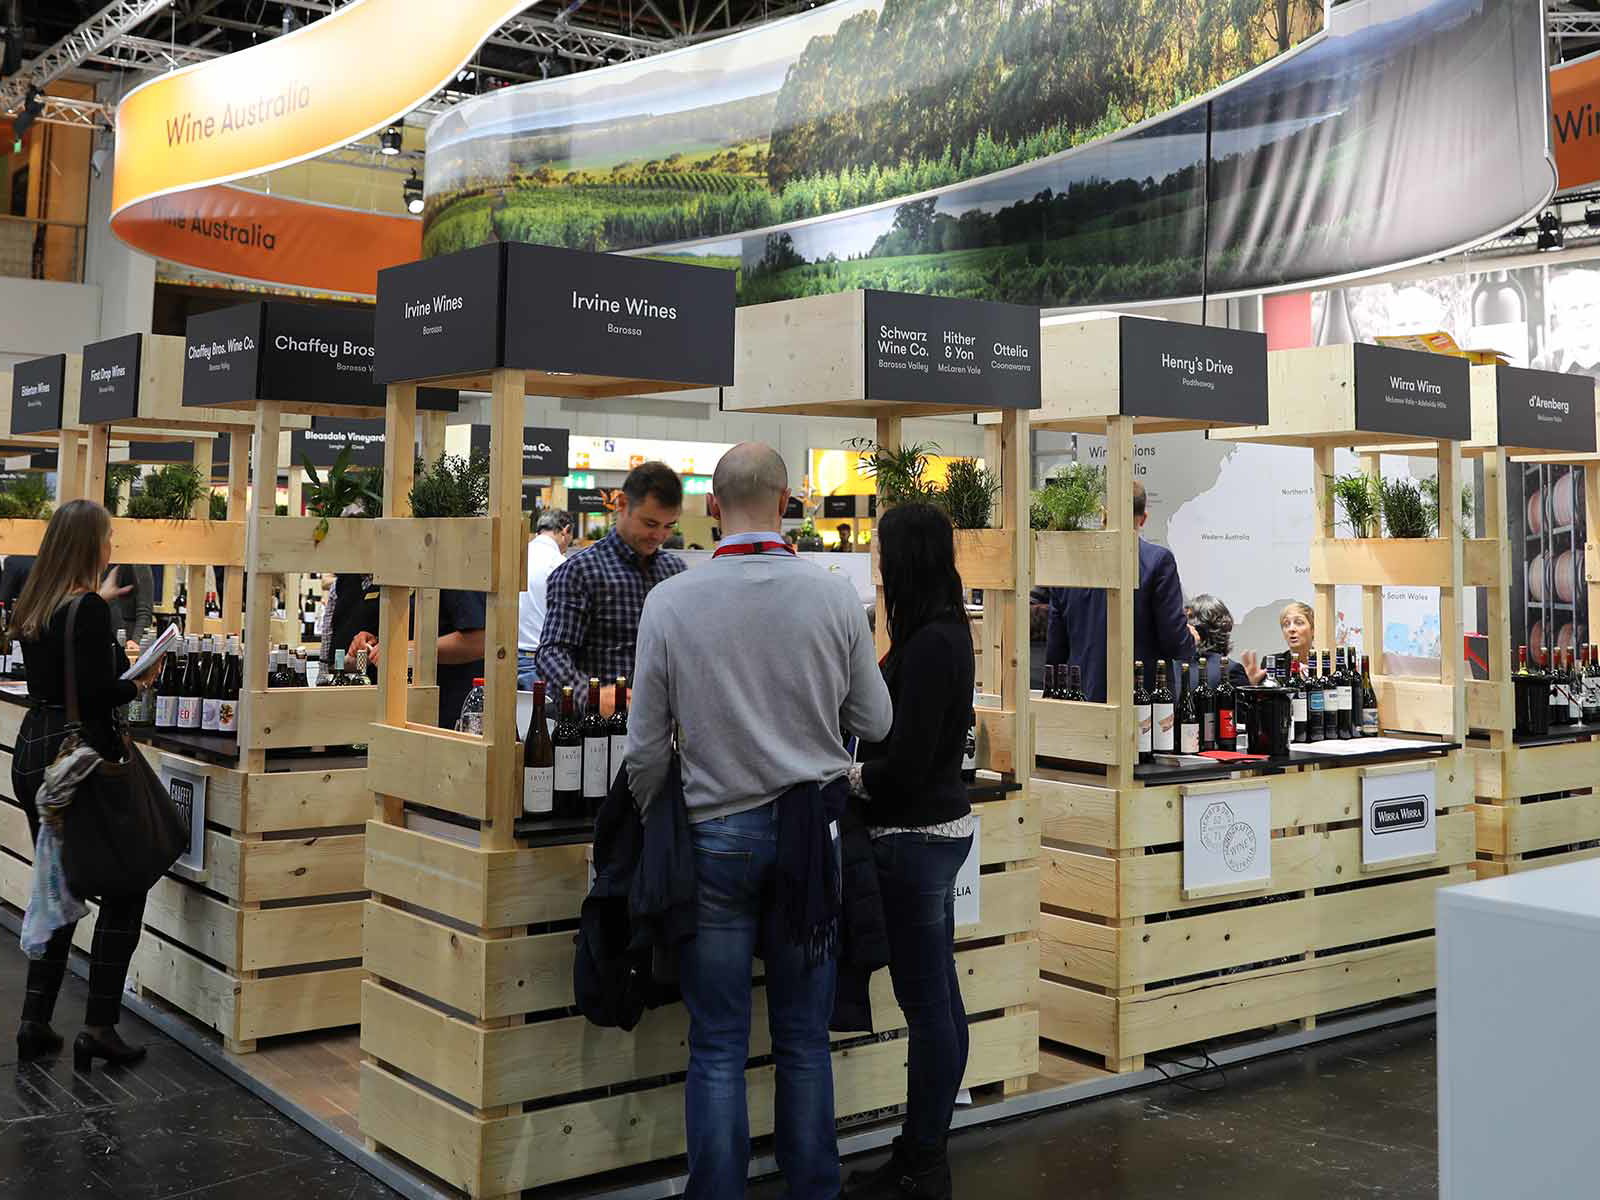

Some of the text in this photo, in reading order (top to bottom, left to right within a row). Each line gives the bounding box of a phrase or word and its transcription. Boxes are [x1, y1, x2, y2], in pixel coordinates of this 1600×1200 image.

[166, 80, 311, 147] Wine Australia
[191, 208, 276, 249] Australia
[404, 295, 463, 319] Irvine Wines
[572, 291, 677, 320] Irvine Wines
[422, 326, 443, 335] Barossa
[607, 322, 642, 336] Barossa
[880, 325, 928, 342] Schwarz
[943, 331, 976, 345] Hither
[188, 335, 255, 360] Chaffey Bros. Wine Co.
[275, 335, 338, 358] Chaffey
[877, 340, 929, 357] Wine Co.
[944, 345, 974, 361] & Yon
[993, 342, 1028, 358] Ottelia
[111, 364, 126, 377] Wines
[336, 362, 367, 372] Barossa
[878, 359, 929, 373] Barossa Valley
[937, 363, 981, 375] McLaren Vale
[991, 360, 1031, 371] Coonawarra
[1161, 353, 1234, 374] Henry's Drive
[1389, 375, 1441, 394] Wirra Wirra
[1528, 395, 1569, 414] d'Arenberg
[305, 430, 346, 441] Bleasdale
[1377, 807, 1422, 823] WIRRA WIRRA
